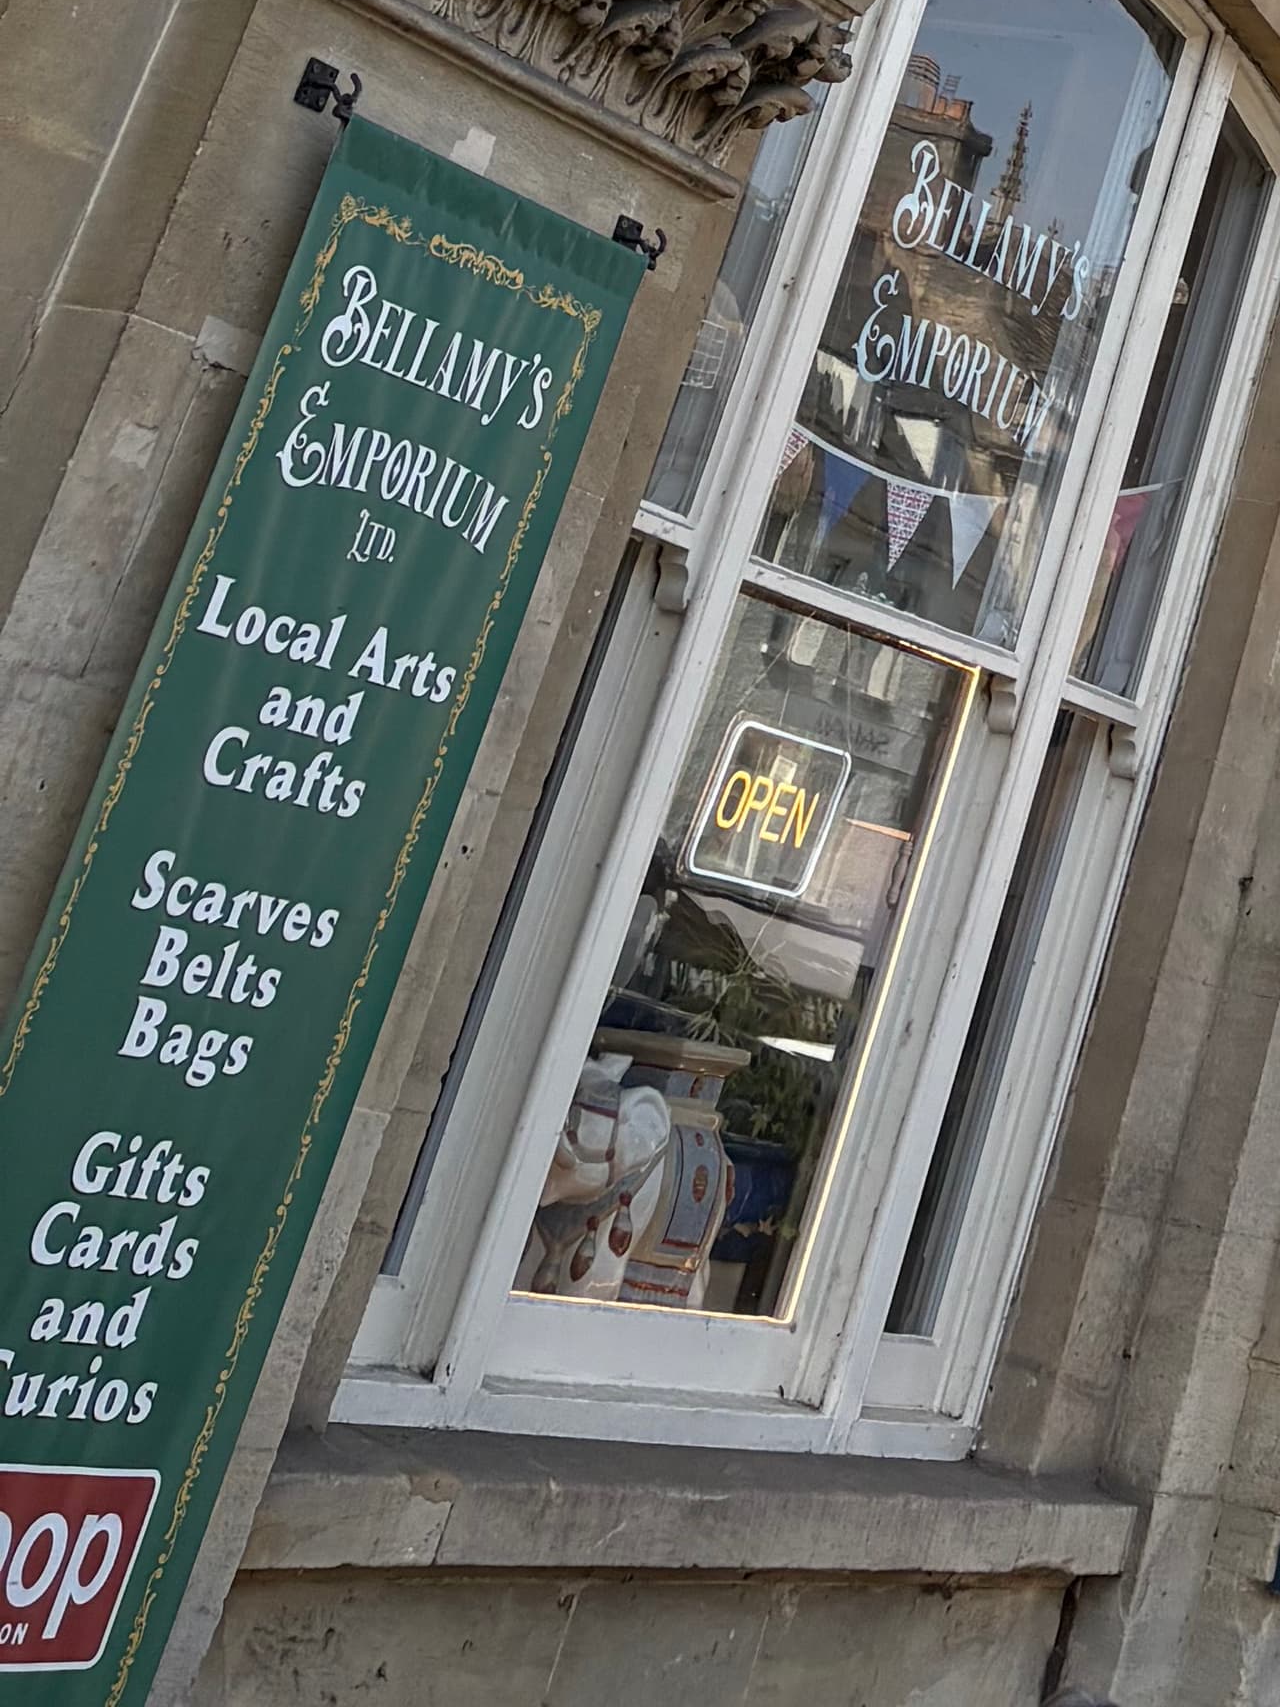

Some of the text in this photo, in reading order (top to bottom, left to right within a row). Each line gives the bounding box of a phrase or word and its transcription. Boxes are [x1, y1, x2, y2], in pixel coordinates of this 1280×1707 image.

[321, 265, 552, 429] BELLAMY'S
[852, 269, 1056, 458] EMPORIUM
[276, 380, 511, 554] EMPORIUM
[196, 574, 457, 702] Local Arts
[259, 686, 365, 746] and
[203, 726, 366, 818] Crafts
[716, 770, 820, 848] OPEN
[131, 849, 340, 948] Scarves
[140, 925, 282, 1008] Belts
[117, 995, 254, 1088] Bags
[71, 1131, 211, 1207] Gifts
[30, 1201, 200, 1279] Cards
[30, 1285, 152, 1349] and
[0, 1348, 158, 1424] urios
[0, 1510, 123, 1639] op
